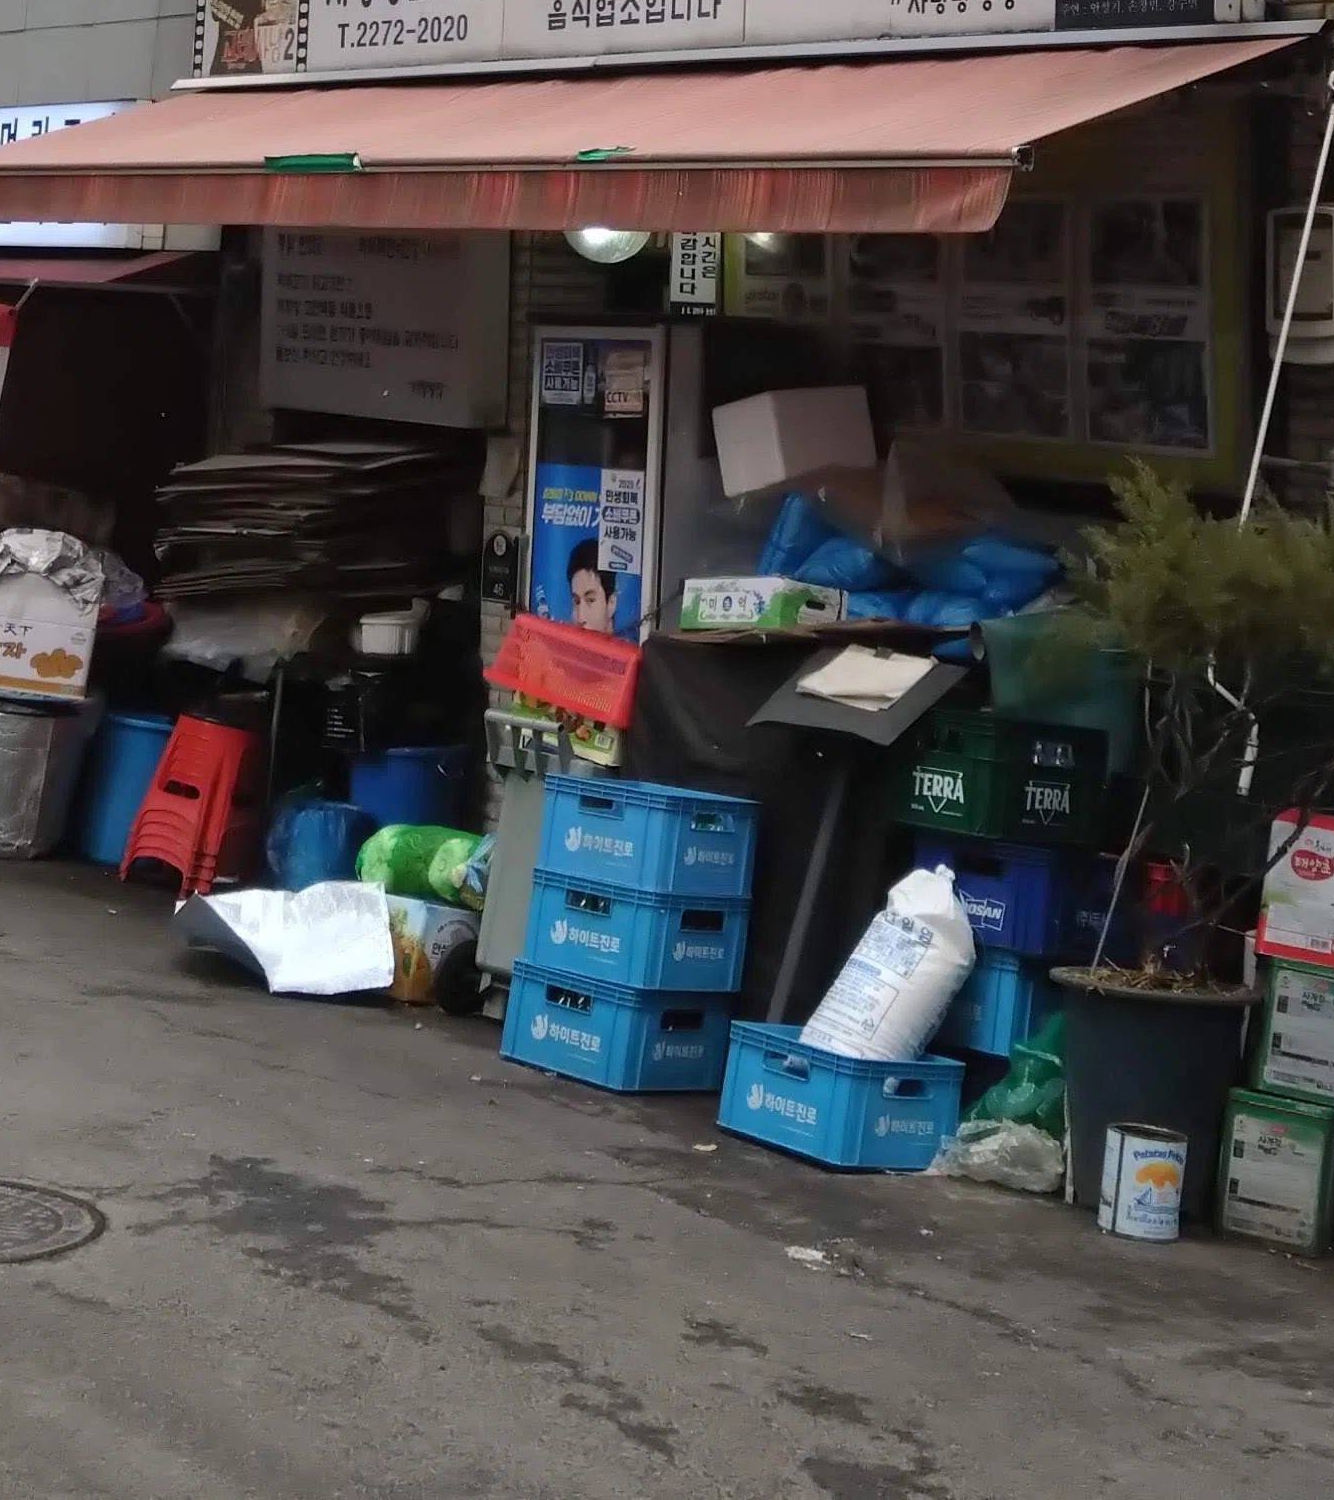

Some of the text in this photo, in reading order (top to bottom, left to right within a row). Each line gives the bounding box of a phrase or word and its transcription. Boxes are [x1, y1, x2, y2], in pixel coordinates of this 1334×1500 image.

[338, 14, 468, 49] T.2272-2020
[607, 391, 627, 403] CCTV
[542, 503, 592, 527] 부담없이
[913, 771, 964, 804] TERRA
[1025, 786, 1071, 814] TERRA
[582, 833, 634, 857] 하이트진로
[569, 928, 620, 953] 하이트진로
[549, 1023, 600, 1052] 하이트진로
[765, 1092, 817, 1125] 하이트진로
